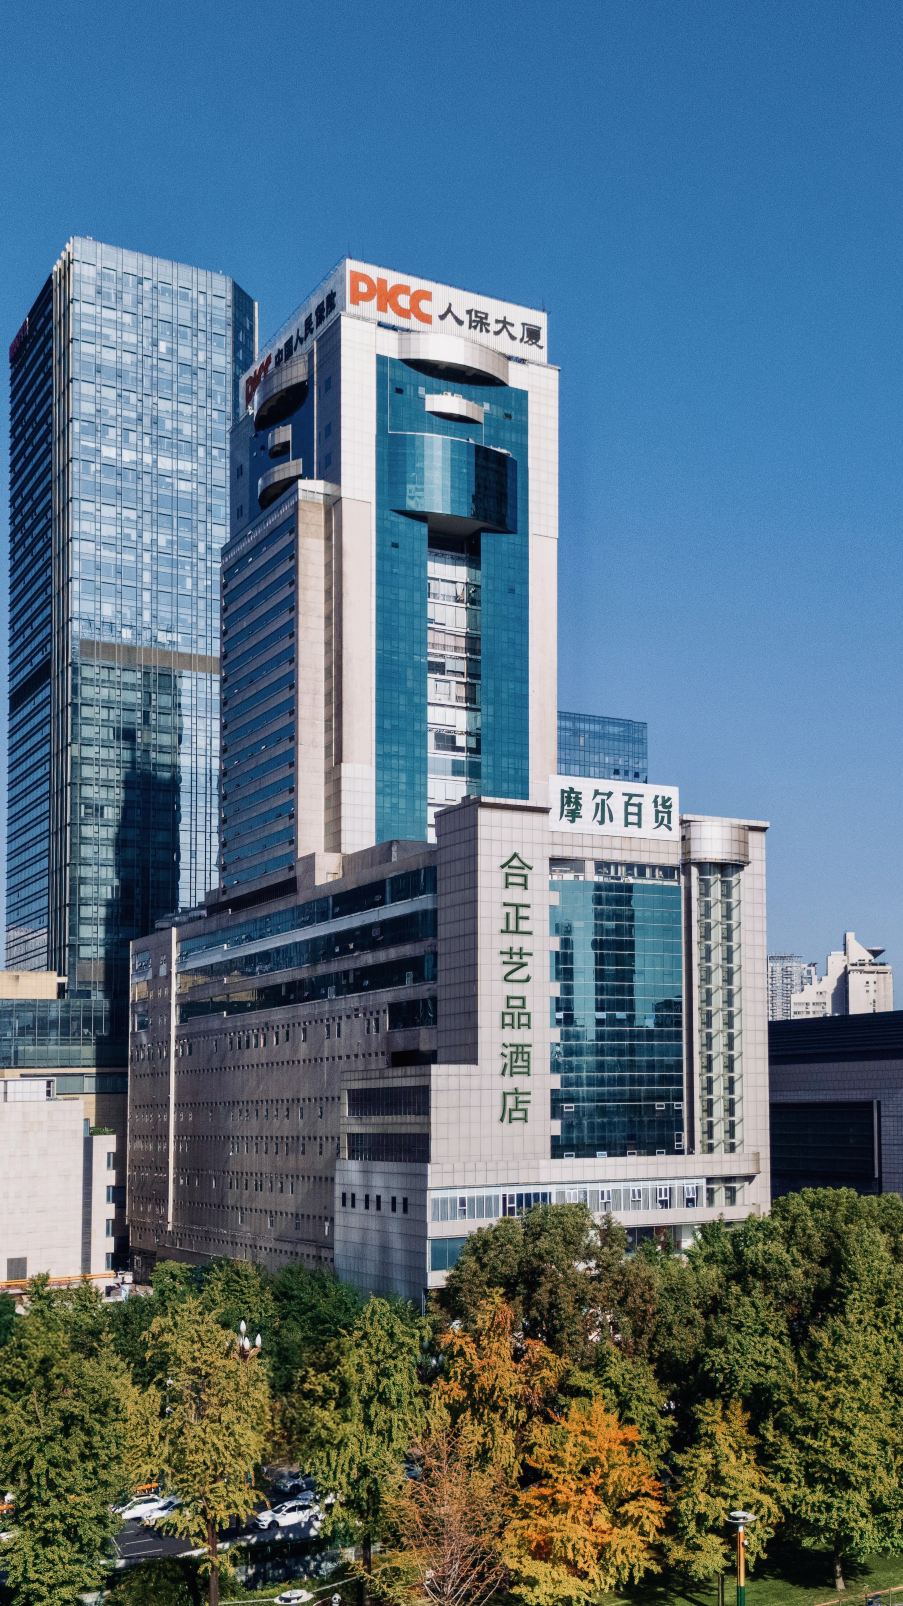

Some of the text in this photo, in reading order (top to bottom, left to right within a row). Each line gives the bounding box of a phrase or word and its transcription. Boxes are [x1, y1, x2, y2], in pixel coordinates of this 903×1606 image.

[349, 270, 432, 325] PICC
[439, 302, 544, 350] 人保大厦
[559, 786, 673, 831] 摩尔百货
[499, 851, 534, 1124] 合正艺品酒店
